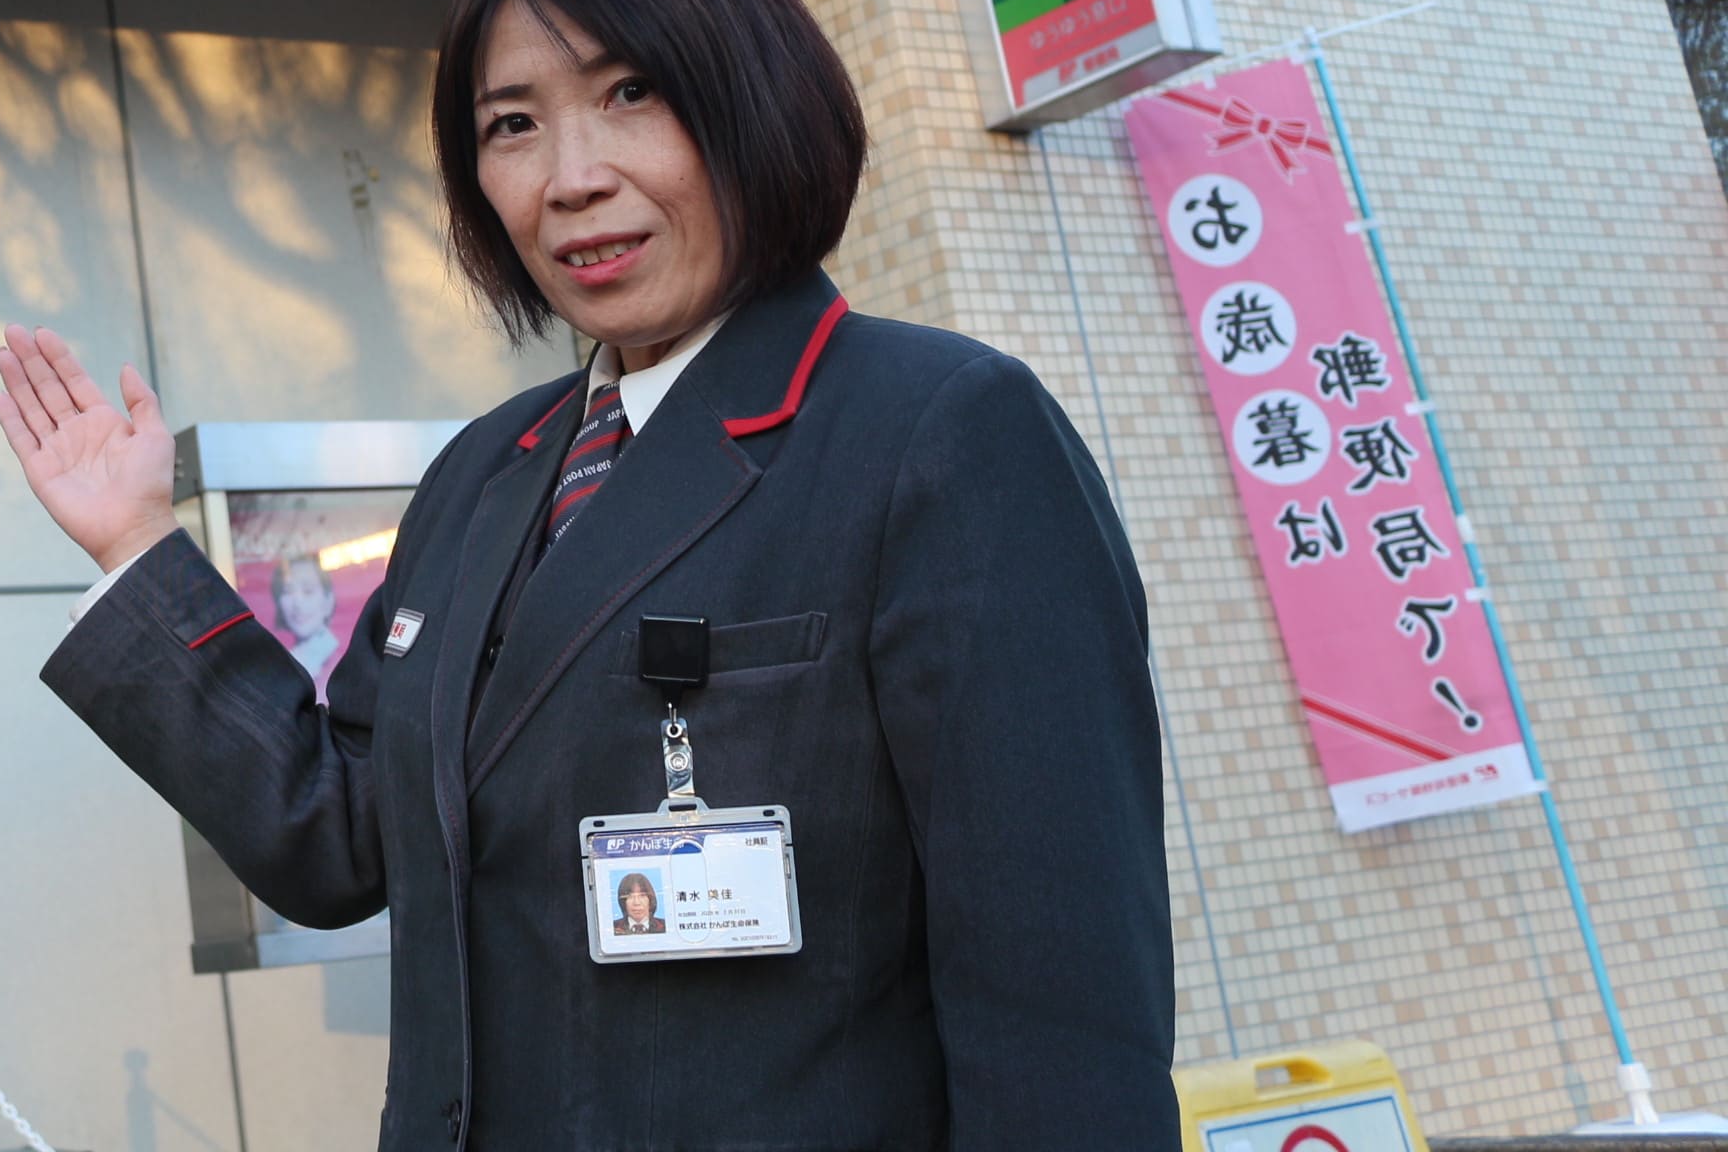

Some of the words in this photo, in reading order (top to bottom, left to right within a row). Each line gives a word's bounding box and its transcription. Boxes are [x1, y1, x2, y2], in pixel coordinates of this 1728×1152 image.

[585, 458, 613, 477] JAPAN
[562, 468, 584, 487] POST
[679, 920, 707, 931] 株式会社
